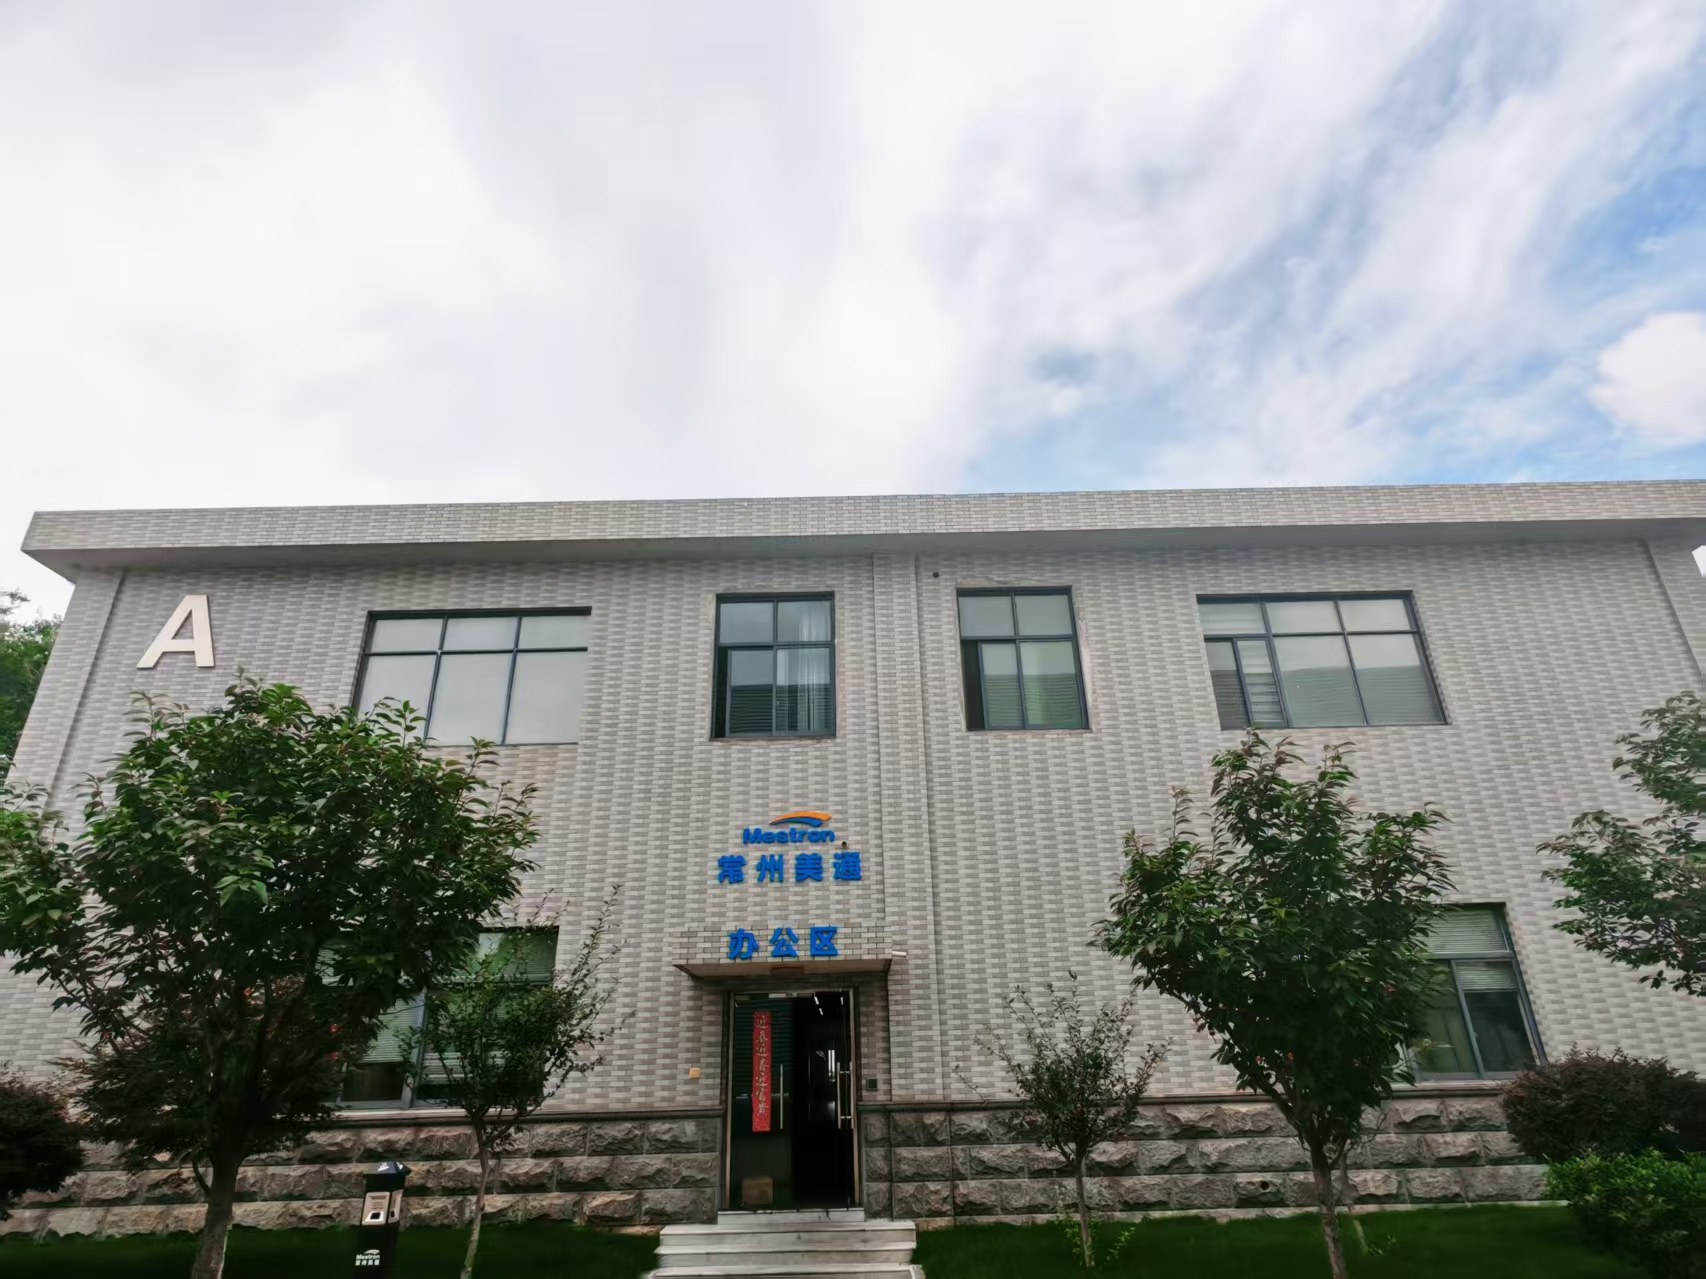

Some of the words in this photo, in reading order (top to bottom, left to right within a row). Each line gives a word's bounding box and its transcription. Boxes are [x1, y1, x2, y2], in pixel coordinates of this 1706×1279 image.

[135, 594, 215, 669] A
[742, 827, 836, 845] Mestron
[717, 851, 862, 884] 常州美通
[728, 926, 839, 960] 办公区
